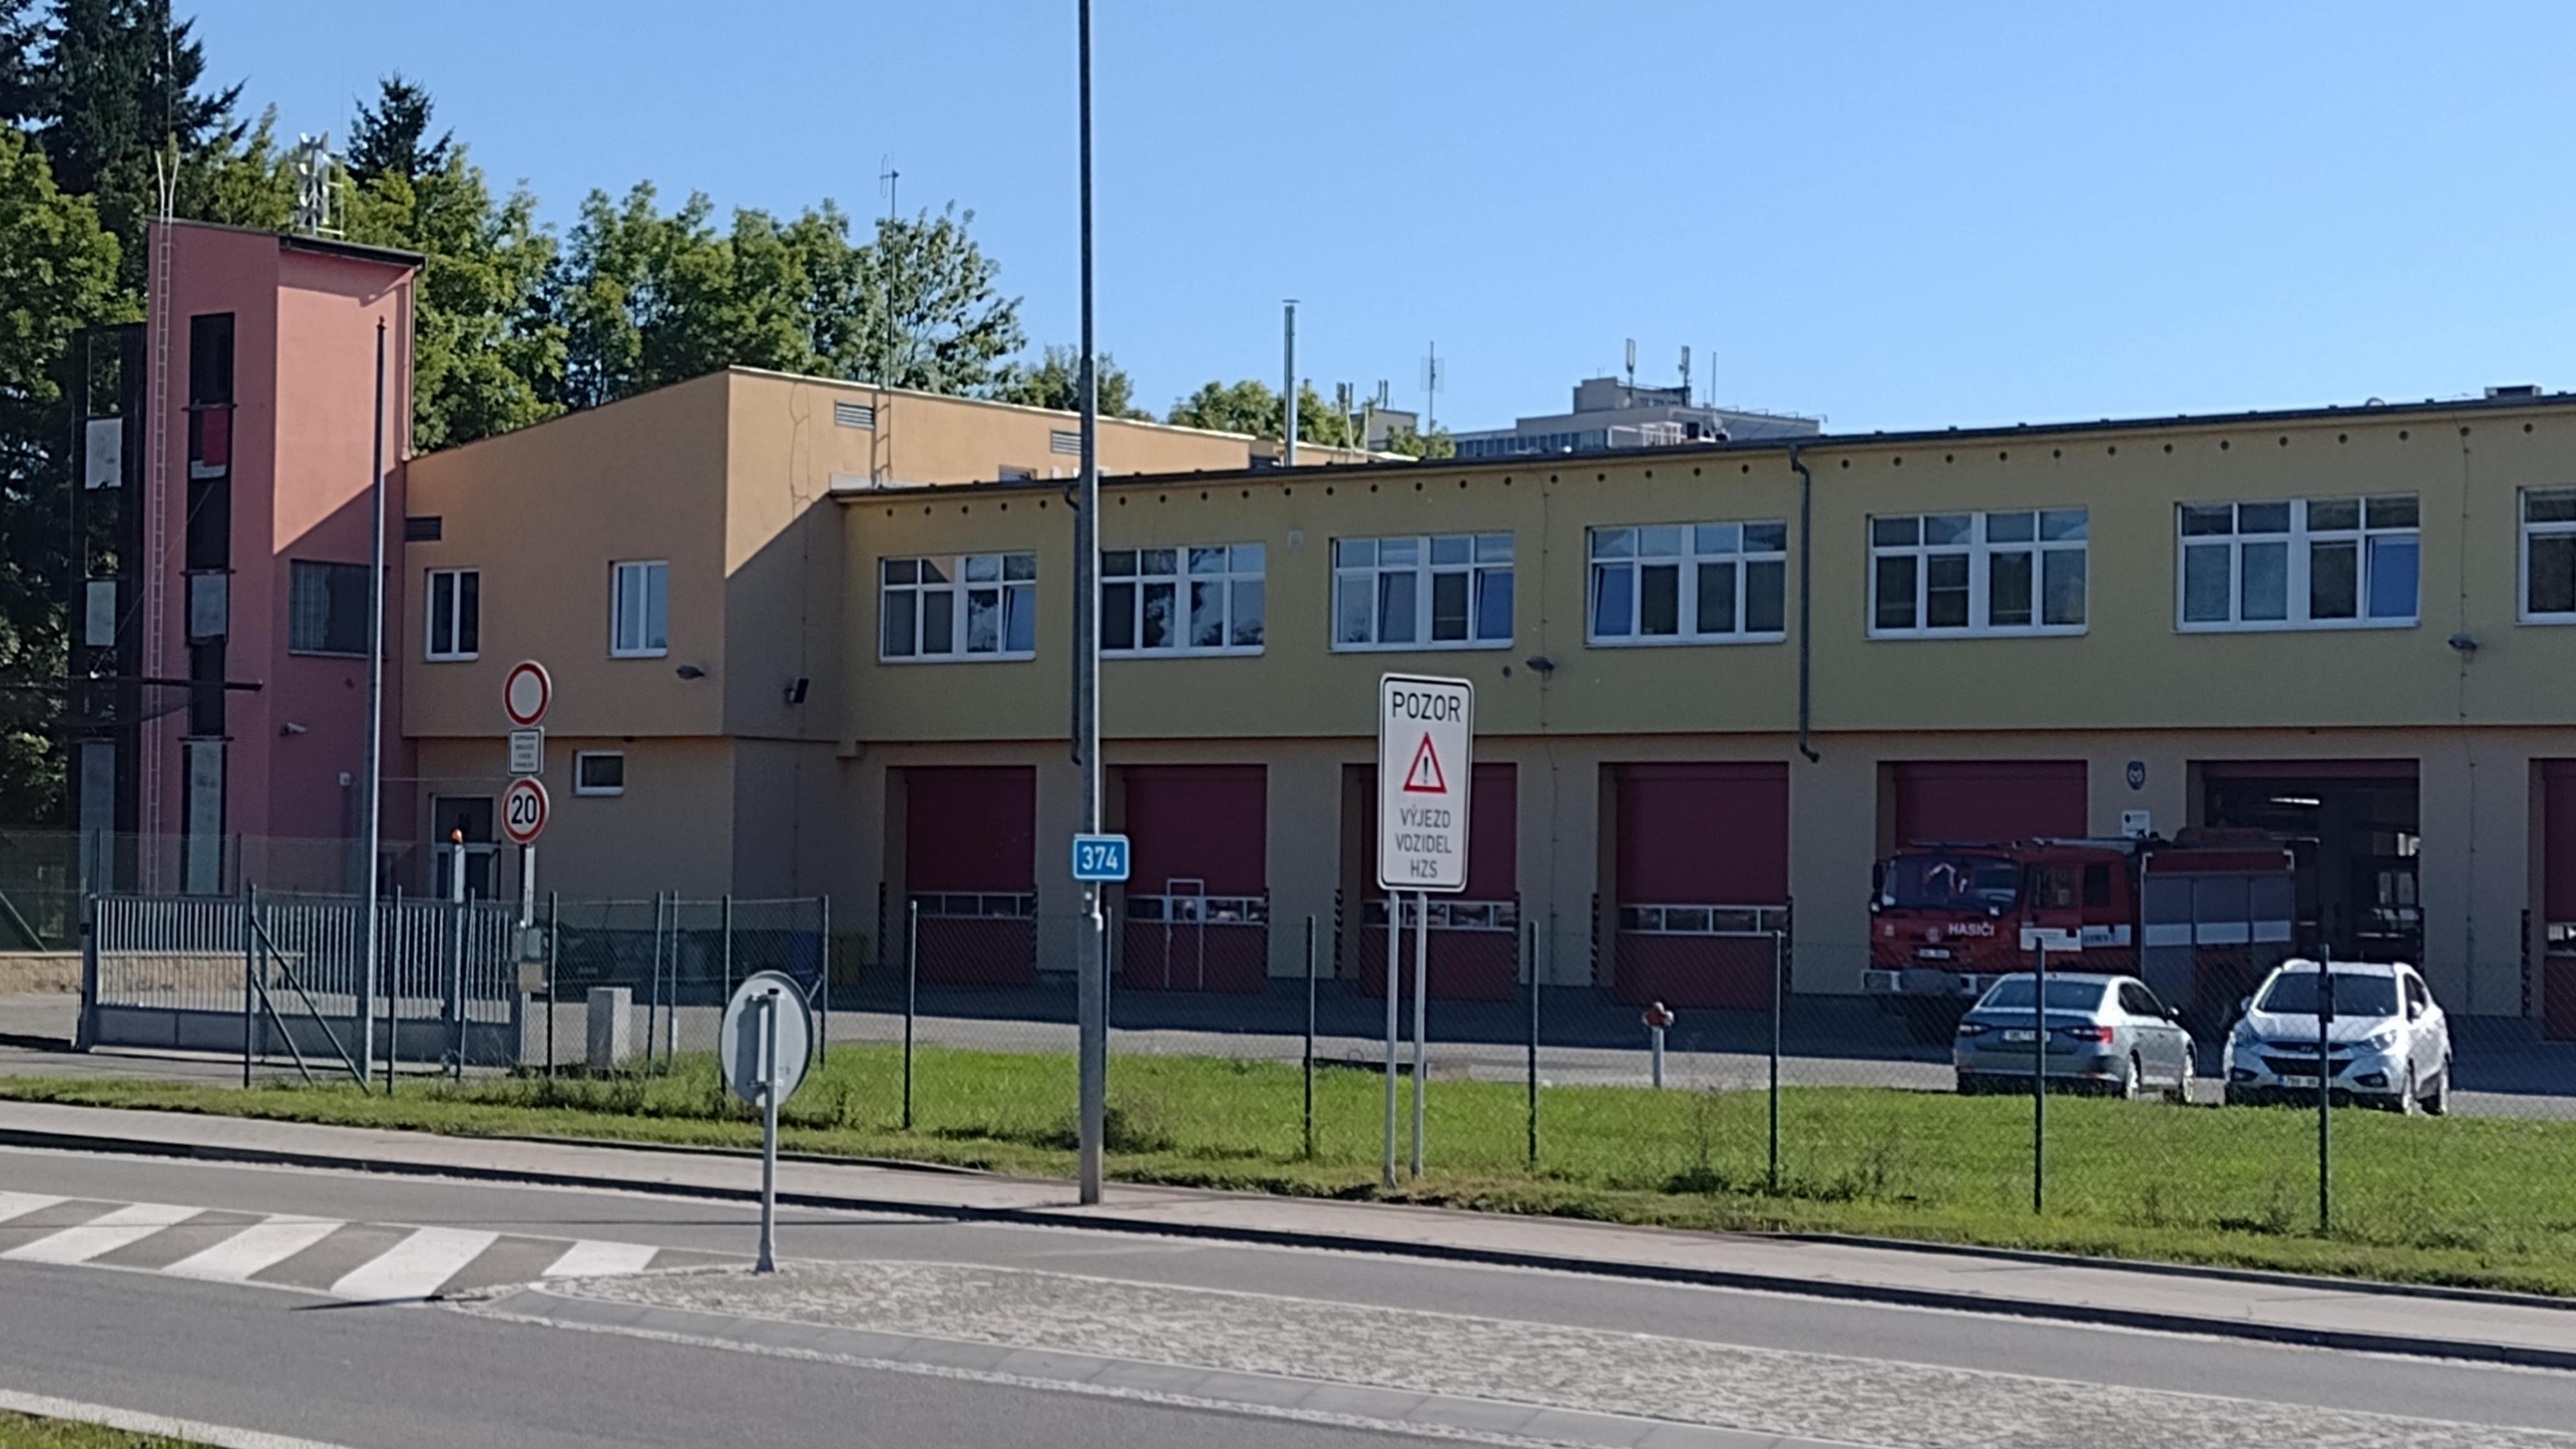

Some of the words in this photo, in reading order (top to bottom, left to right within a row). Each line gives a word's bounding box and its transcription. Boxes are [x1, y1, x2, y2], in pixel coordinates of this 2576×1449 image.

[1392, 691, 1461, 723] POZOR
[511, 794, 537, 825] 20
[1400, 804, 1452, 829] VÝJEZD
[1395, 833, 1452, 854] VOZIDEL
[1083, 845, 1119, 871] 374
[1410, 858, 1438, 878] HZS
[1949, 922, 1995, 937] HASIČI
